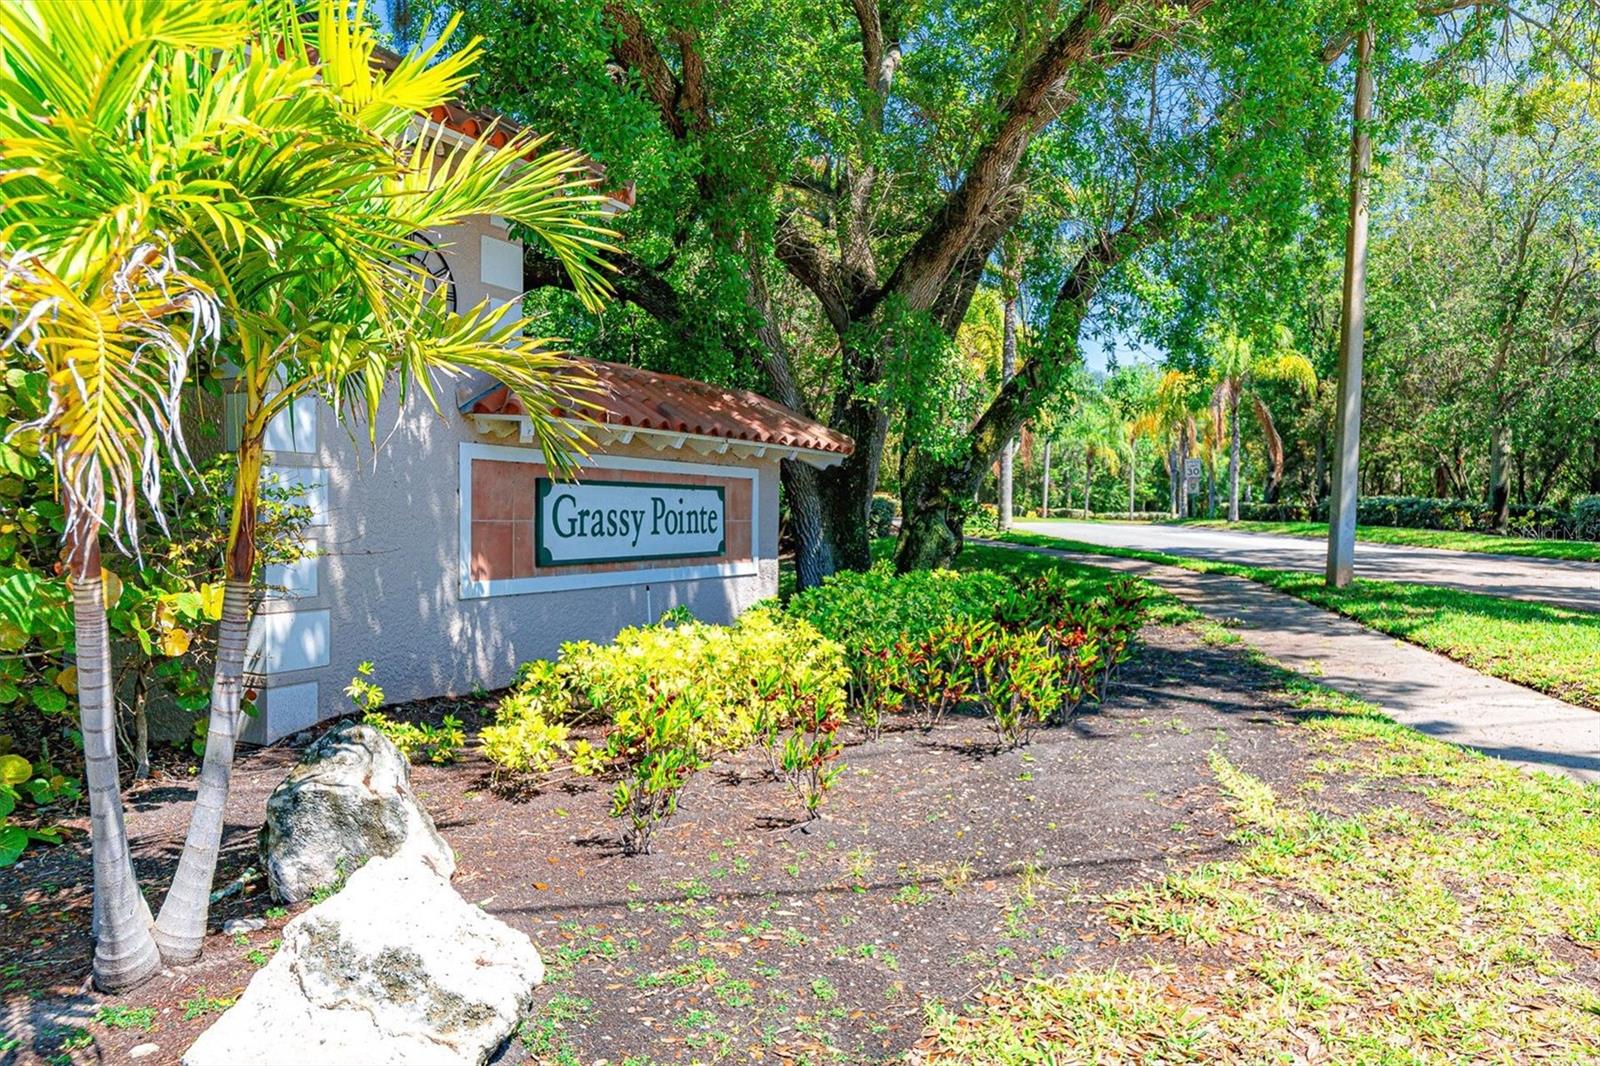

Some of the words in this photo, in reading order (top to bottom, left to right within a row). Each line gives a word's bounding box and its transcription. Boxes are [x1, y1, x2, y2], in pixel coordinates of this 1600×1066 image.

[1186, 467, 1200, 476] 30
[552, 494, 645, 547] Grassy
[651, 497, 718, 535] Pointe
